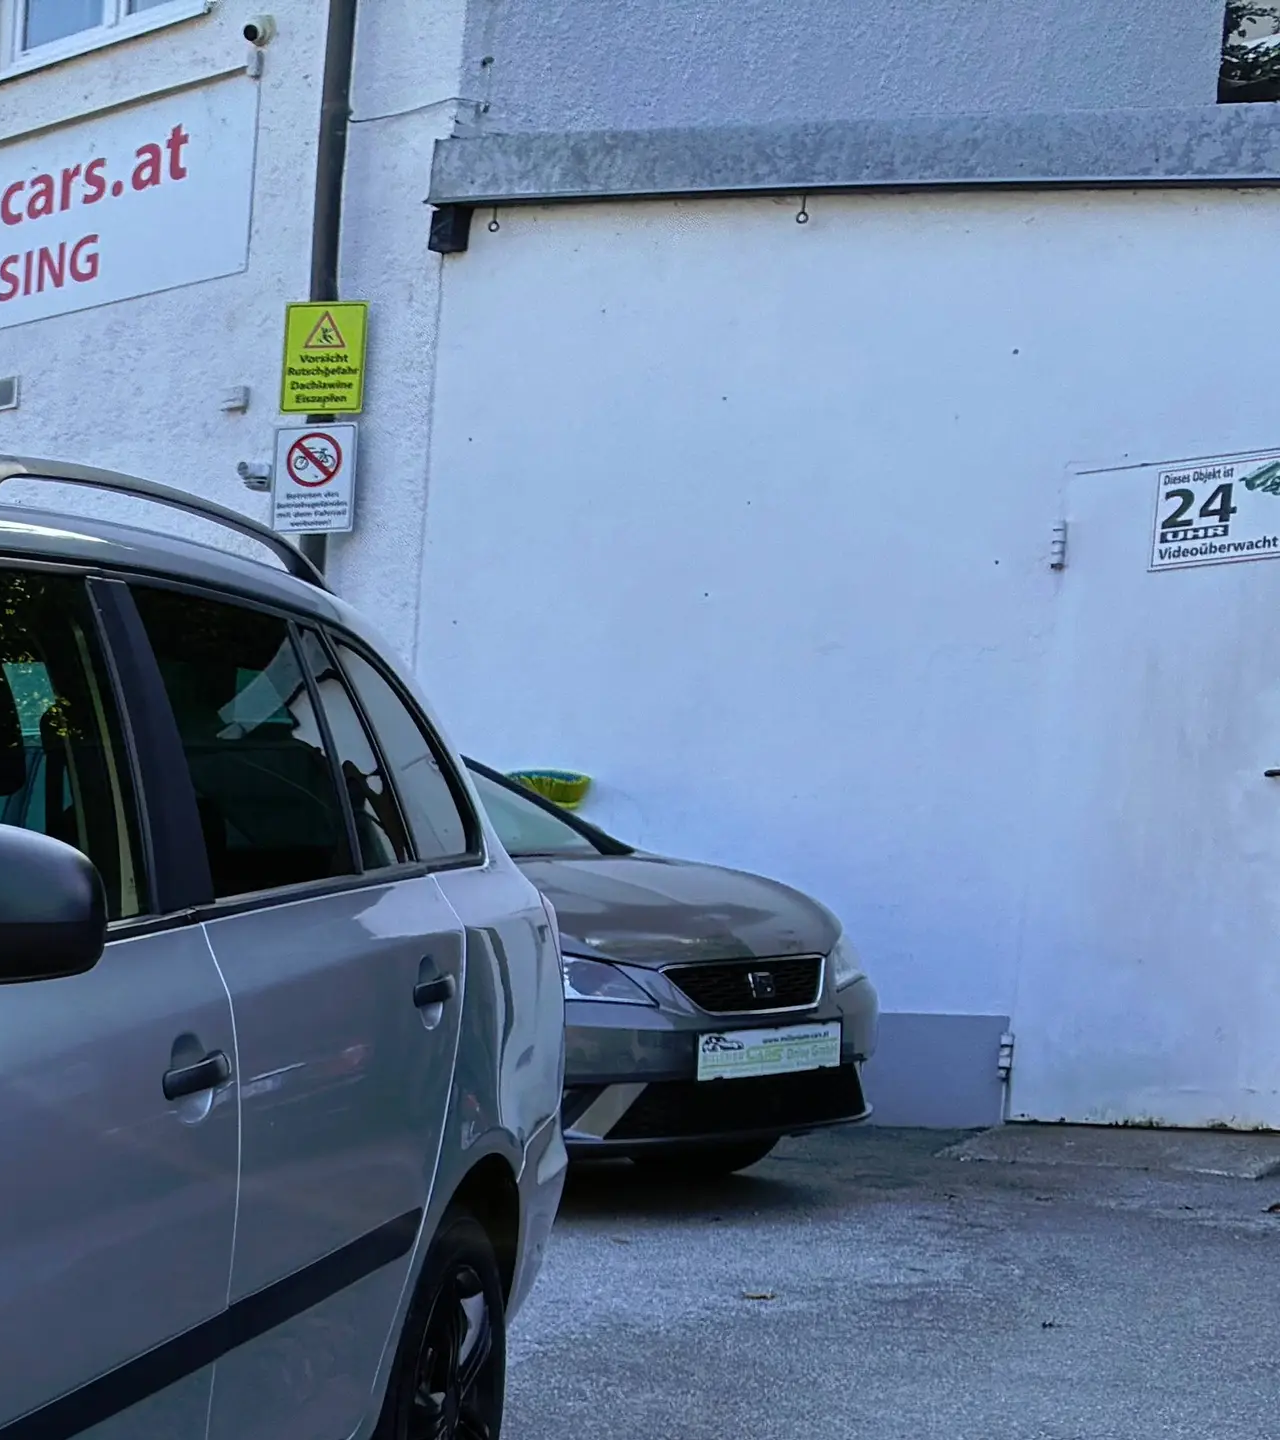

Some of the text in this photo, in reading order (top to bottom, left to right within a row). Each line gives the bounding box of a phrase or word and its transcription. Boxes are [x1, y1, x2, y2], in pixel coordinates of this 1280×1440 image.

[300, 352, 348, 363] Vorsicht
[1163, 467, 1235, 486] Dieses Objekt ist
[1161, 482, 1237, 530] 24
[1166, 527, 1225, 542] UHR
[1158, 535, 1279, 561] Videoüberwacht
